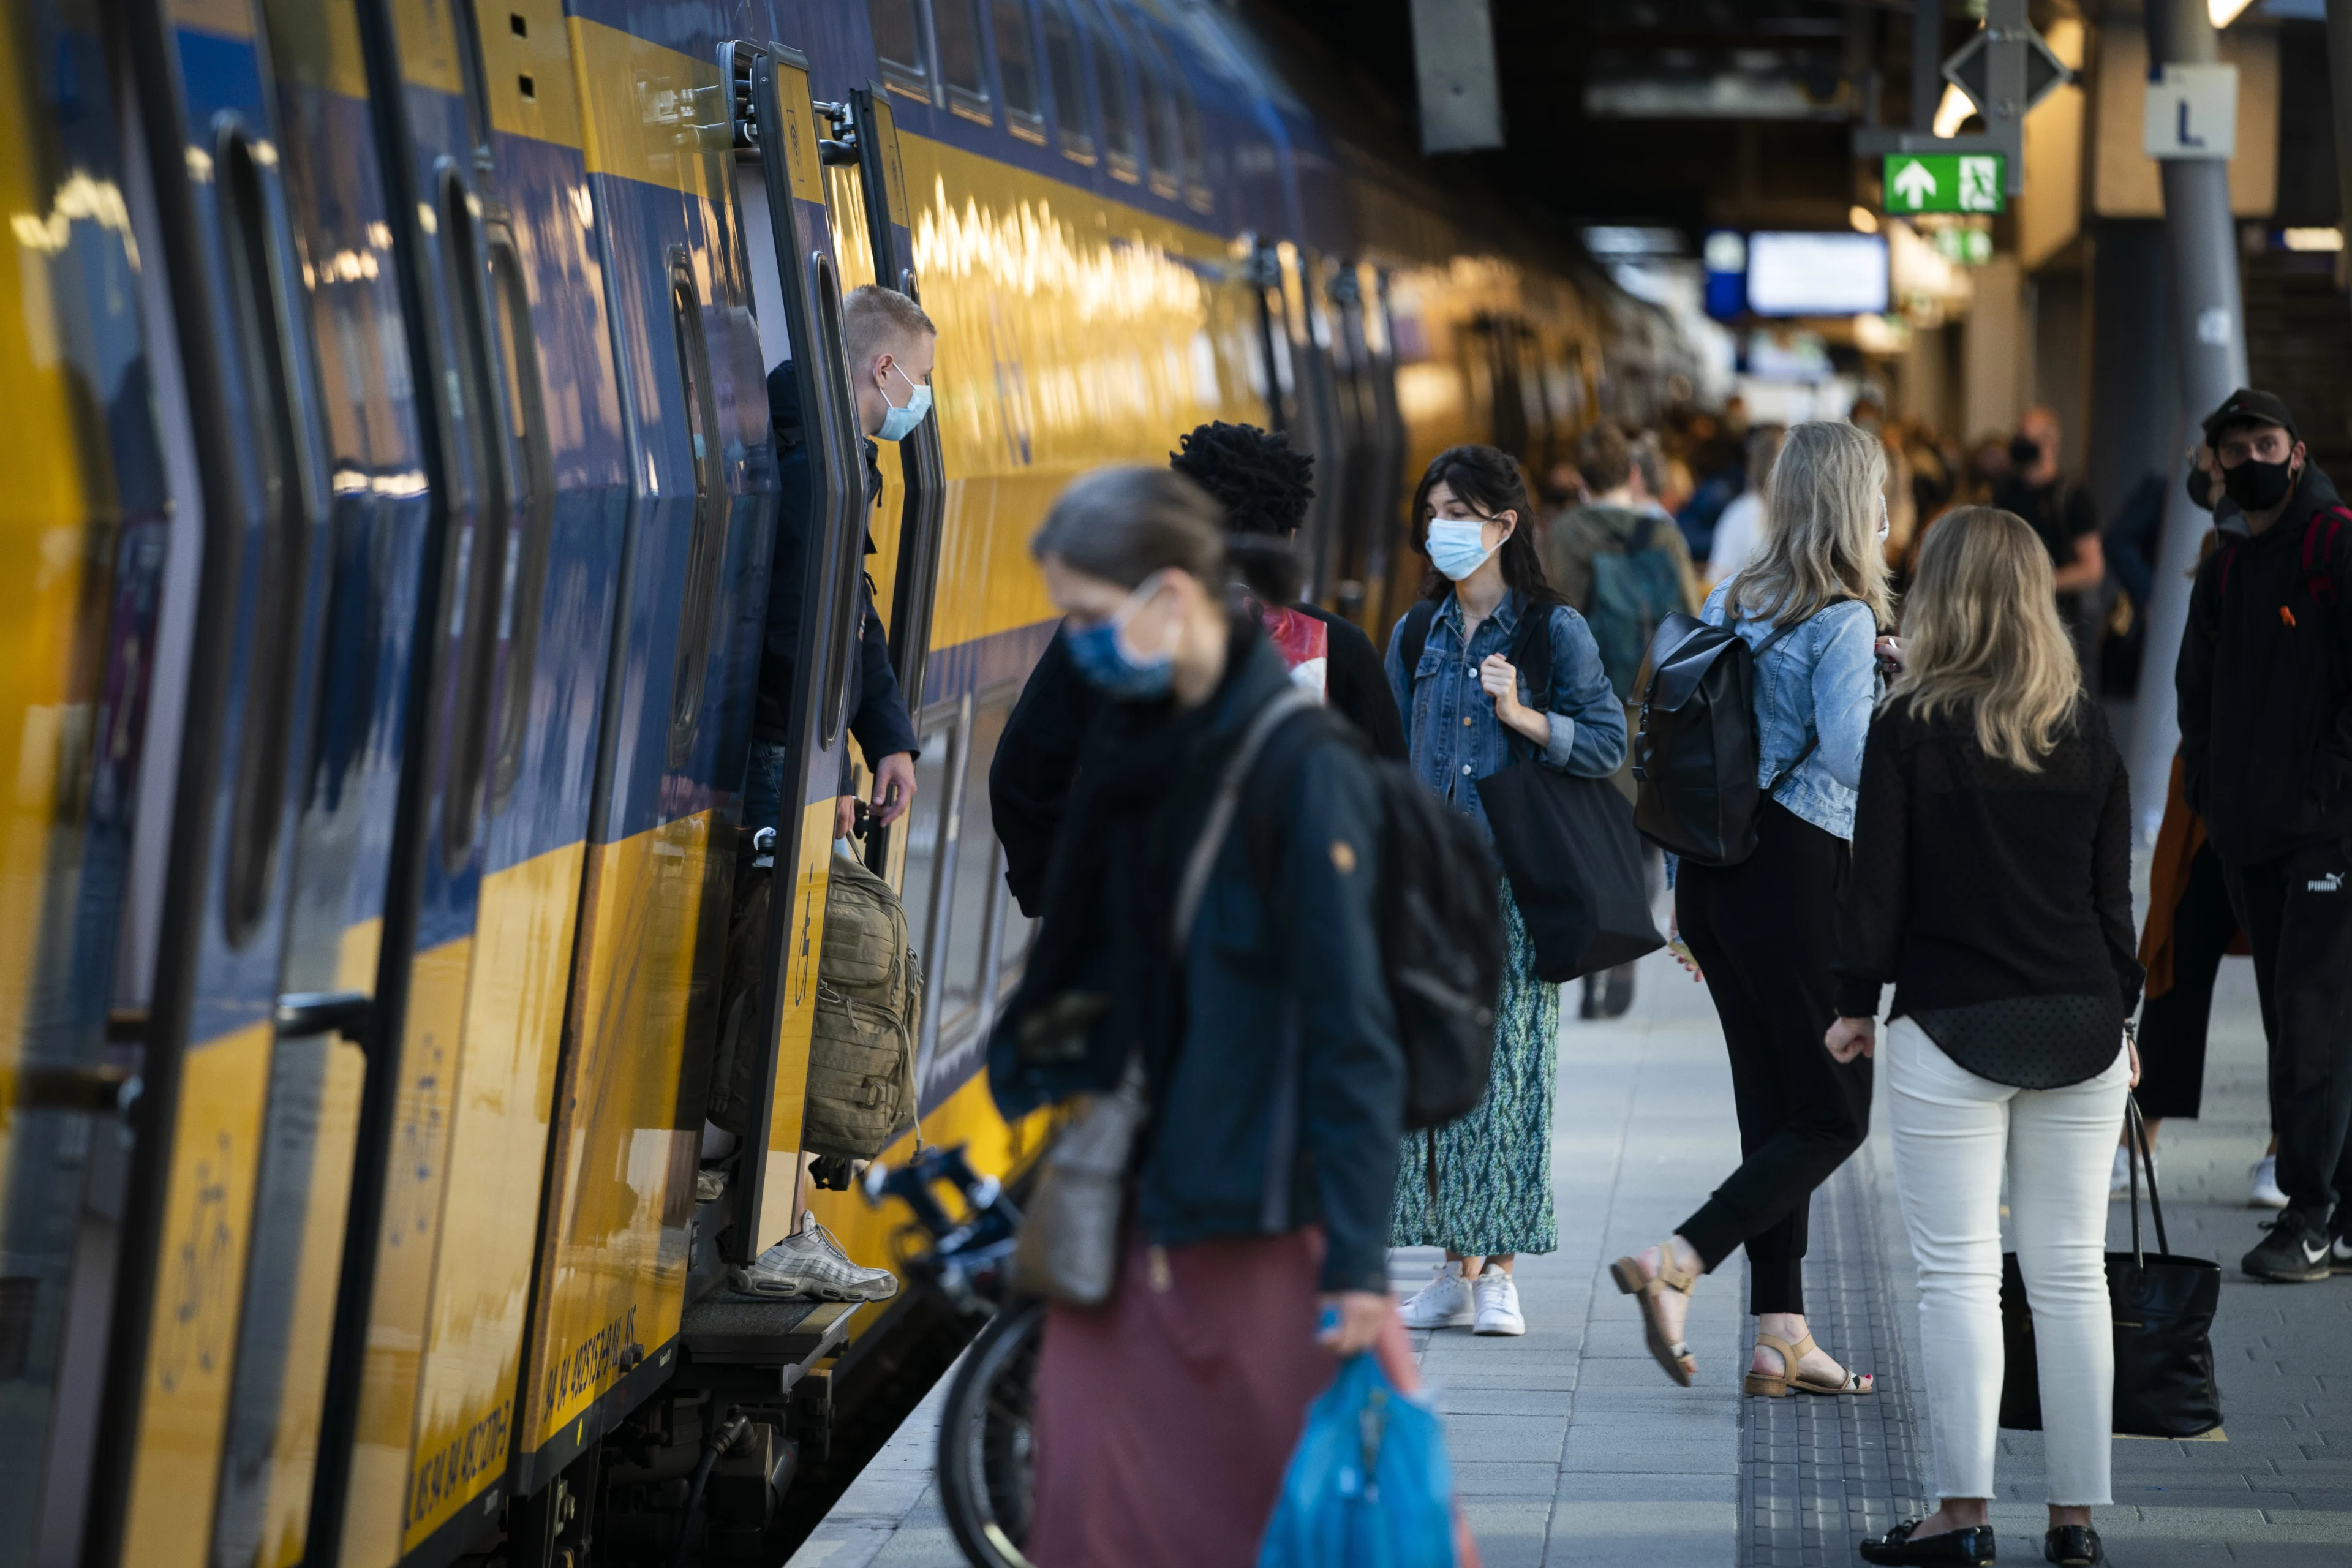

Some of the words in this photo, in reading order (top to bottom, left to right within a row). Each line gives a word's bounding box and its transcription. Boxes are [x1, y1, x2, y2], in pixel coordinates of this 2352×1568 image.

[2179, 99, 2206, 146] L
[2307, 880, 2337, 892] PUMA
[557, 1354, 571, 1412] 84
